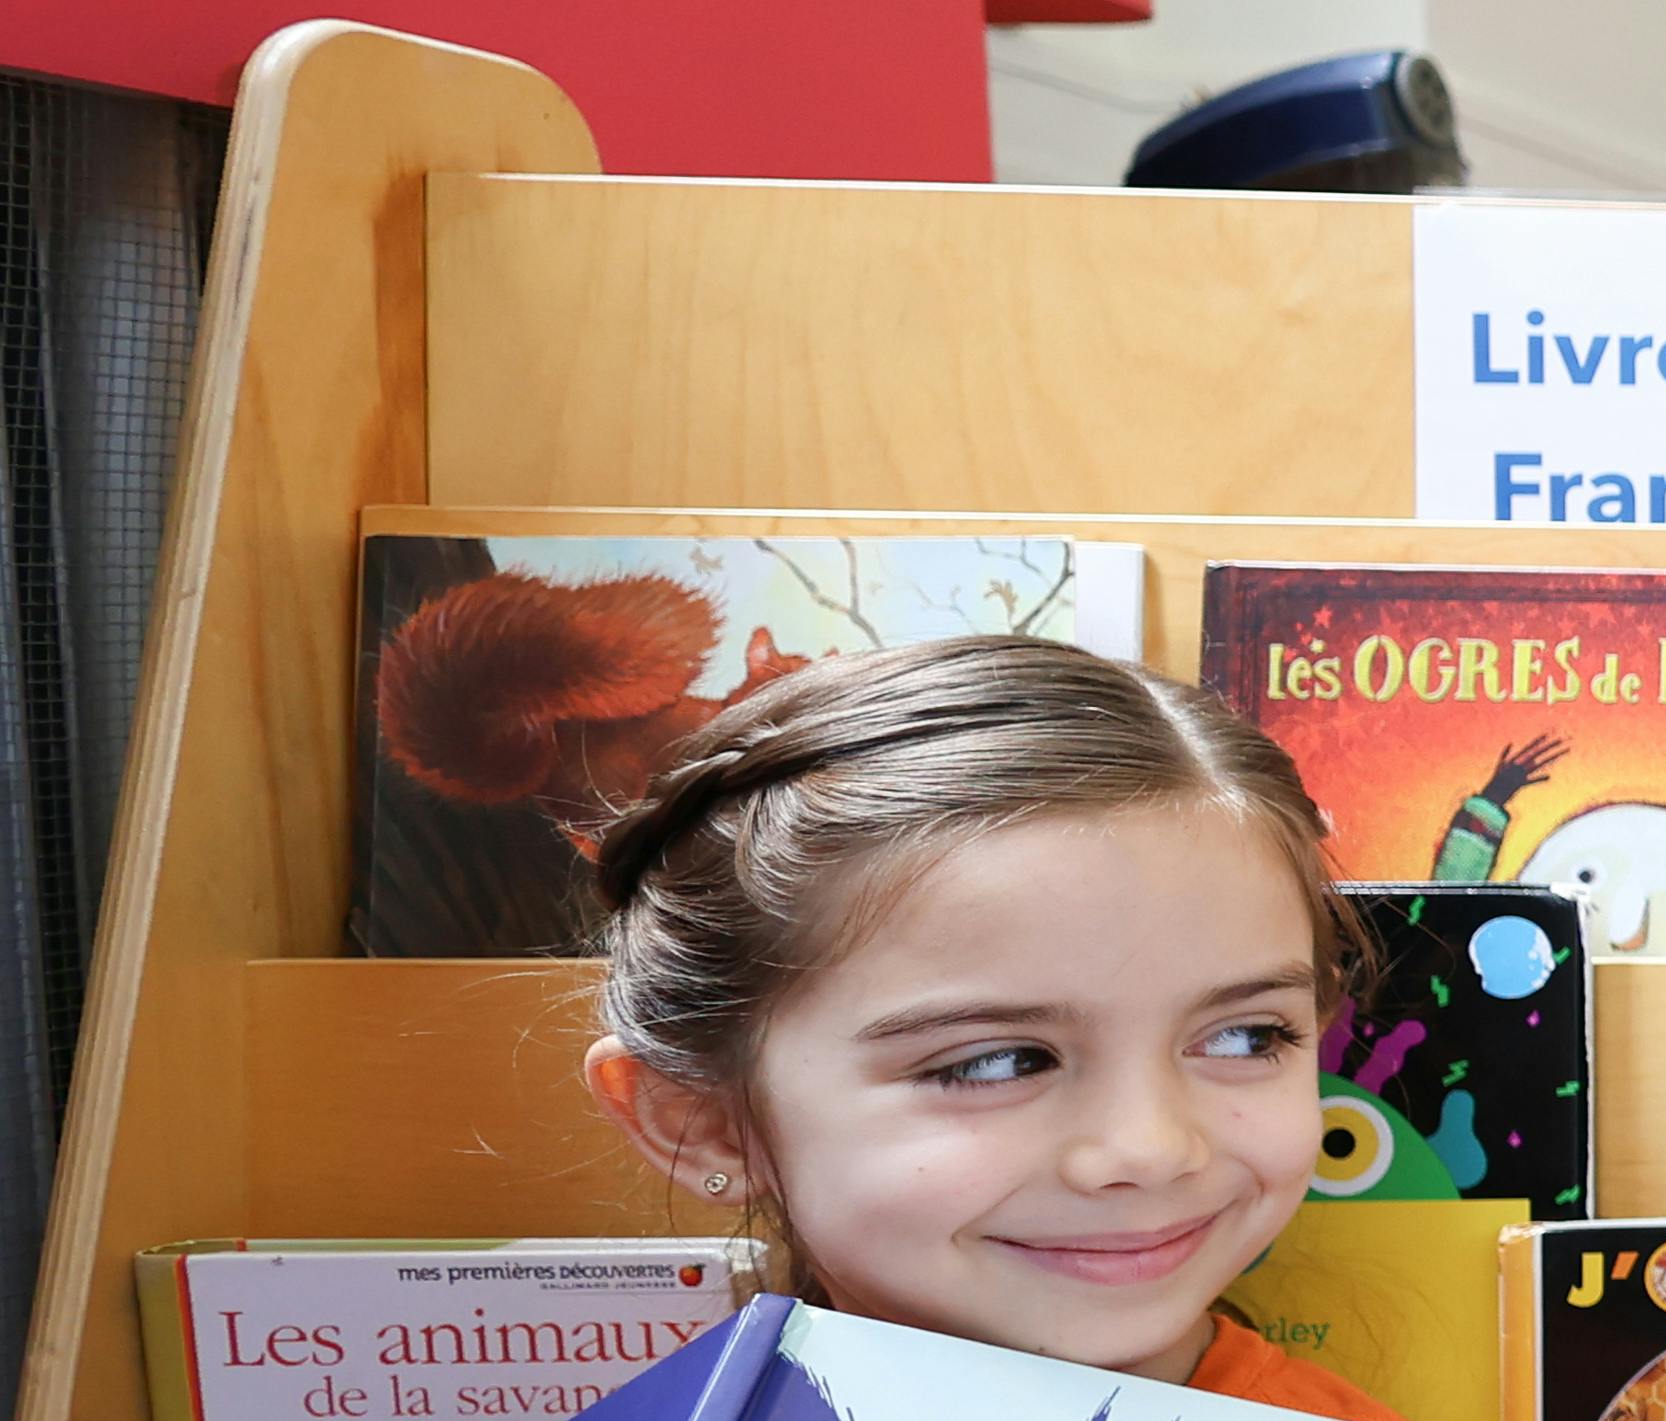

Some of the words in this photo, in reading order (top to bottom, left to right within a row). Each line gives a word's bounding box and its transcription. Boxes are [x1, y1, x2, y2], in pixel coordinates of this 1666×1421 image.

[1354, 635, 1581, 705] OGRES
[1591, 653, 1642, 704] de
[397, 1266, 441, 1282] mes
[448, 1260, 556, 1286] premières
[218, 1310, 345, 1369] Les
[304, 1375, 368, 1418] de
[391, 1376, 433, 1418] la
[456, 1382, 615, 1417] savan
